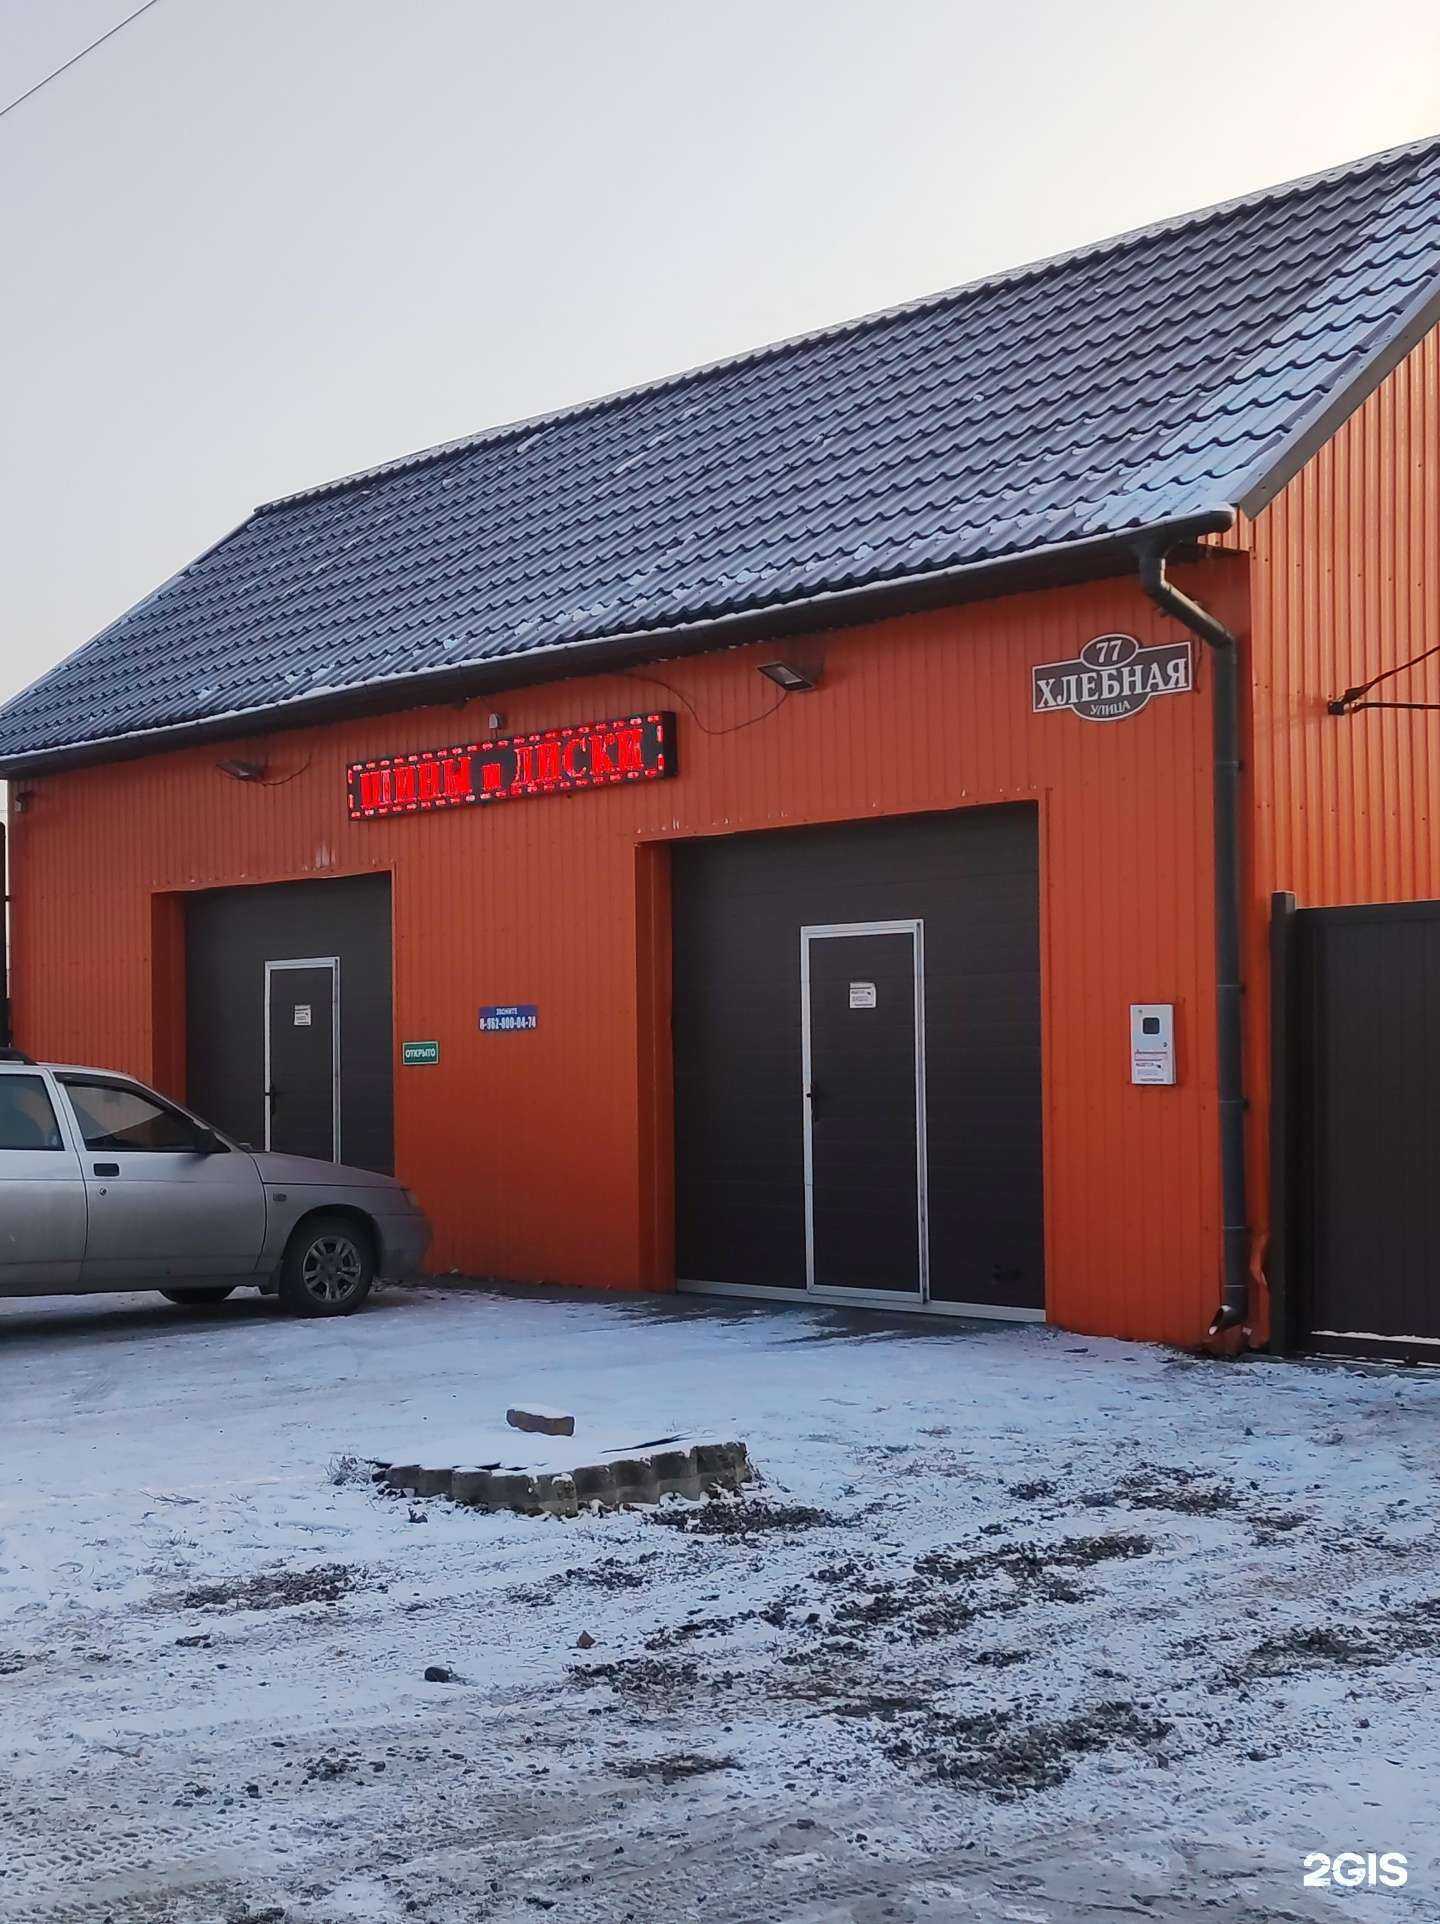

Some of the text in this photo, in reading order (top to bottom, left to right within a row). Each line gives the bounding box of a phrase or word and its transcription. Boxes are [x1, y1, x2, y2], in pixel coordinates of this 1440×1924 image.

[1096, 640, 1122, 663] 77
[1037, 658, 1187, 707] ХЛЕБНАЯ
[1089, 700, 1131, 716] УЛИЦА
[360, 757, 472, 809] ШИНЫ
[511, 729, 644, 784] ДИСКИ
[405, 1048, 435, 1058] ОТКРЫТО
